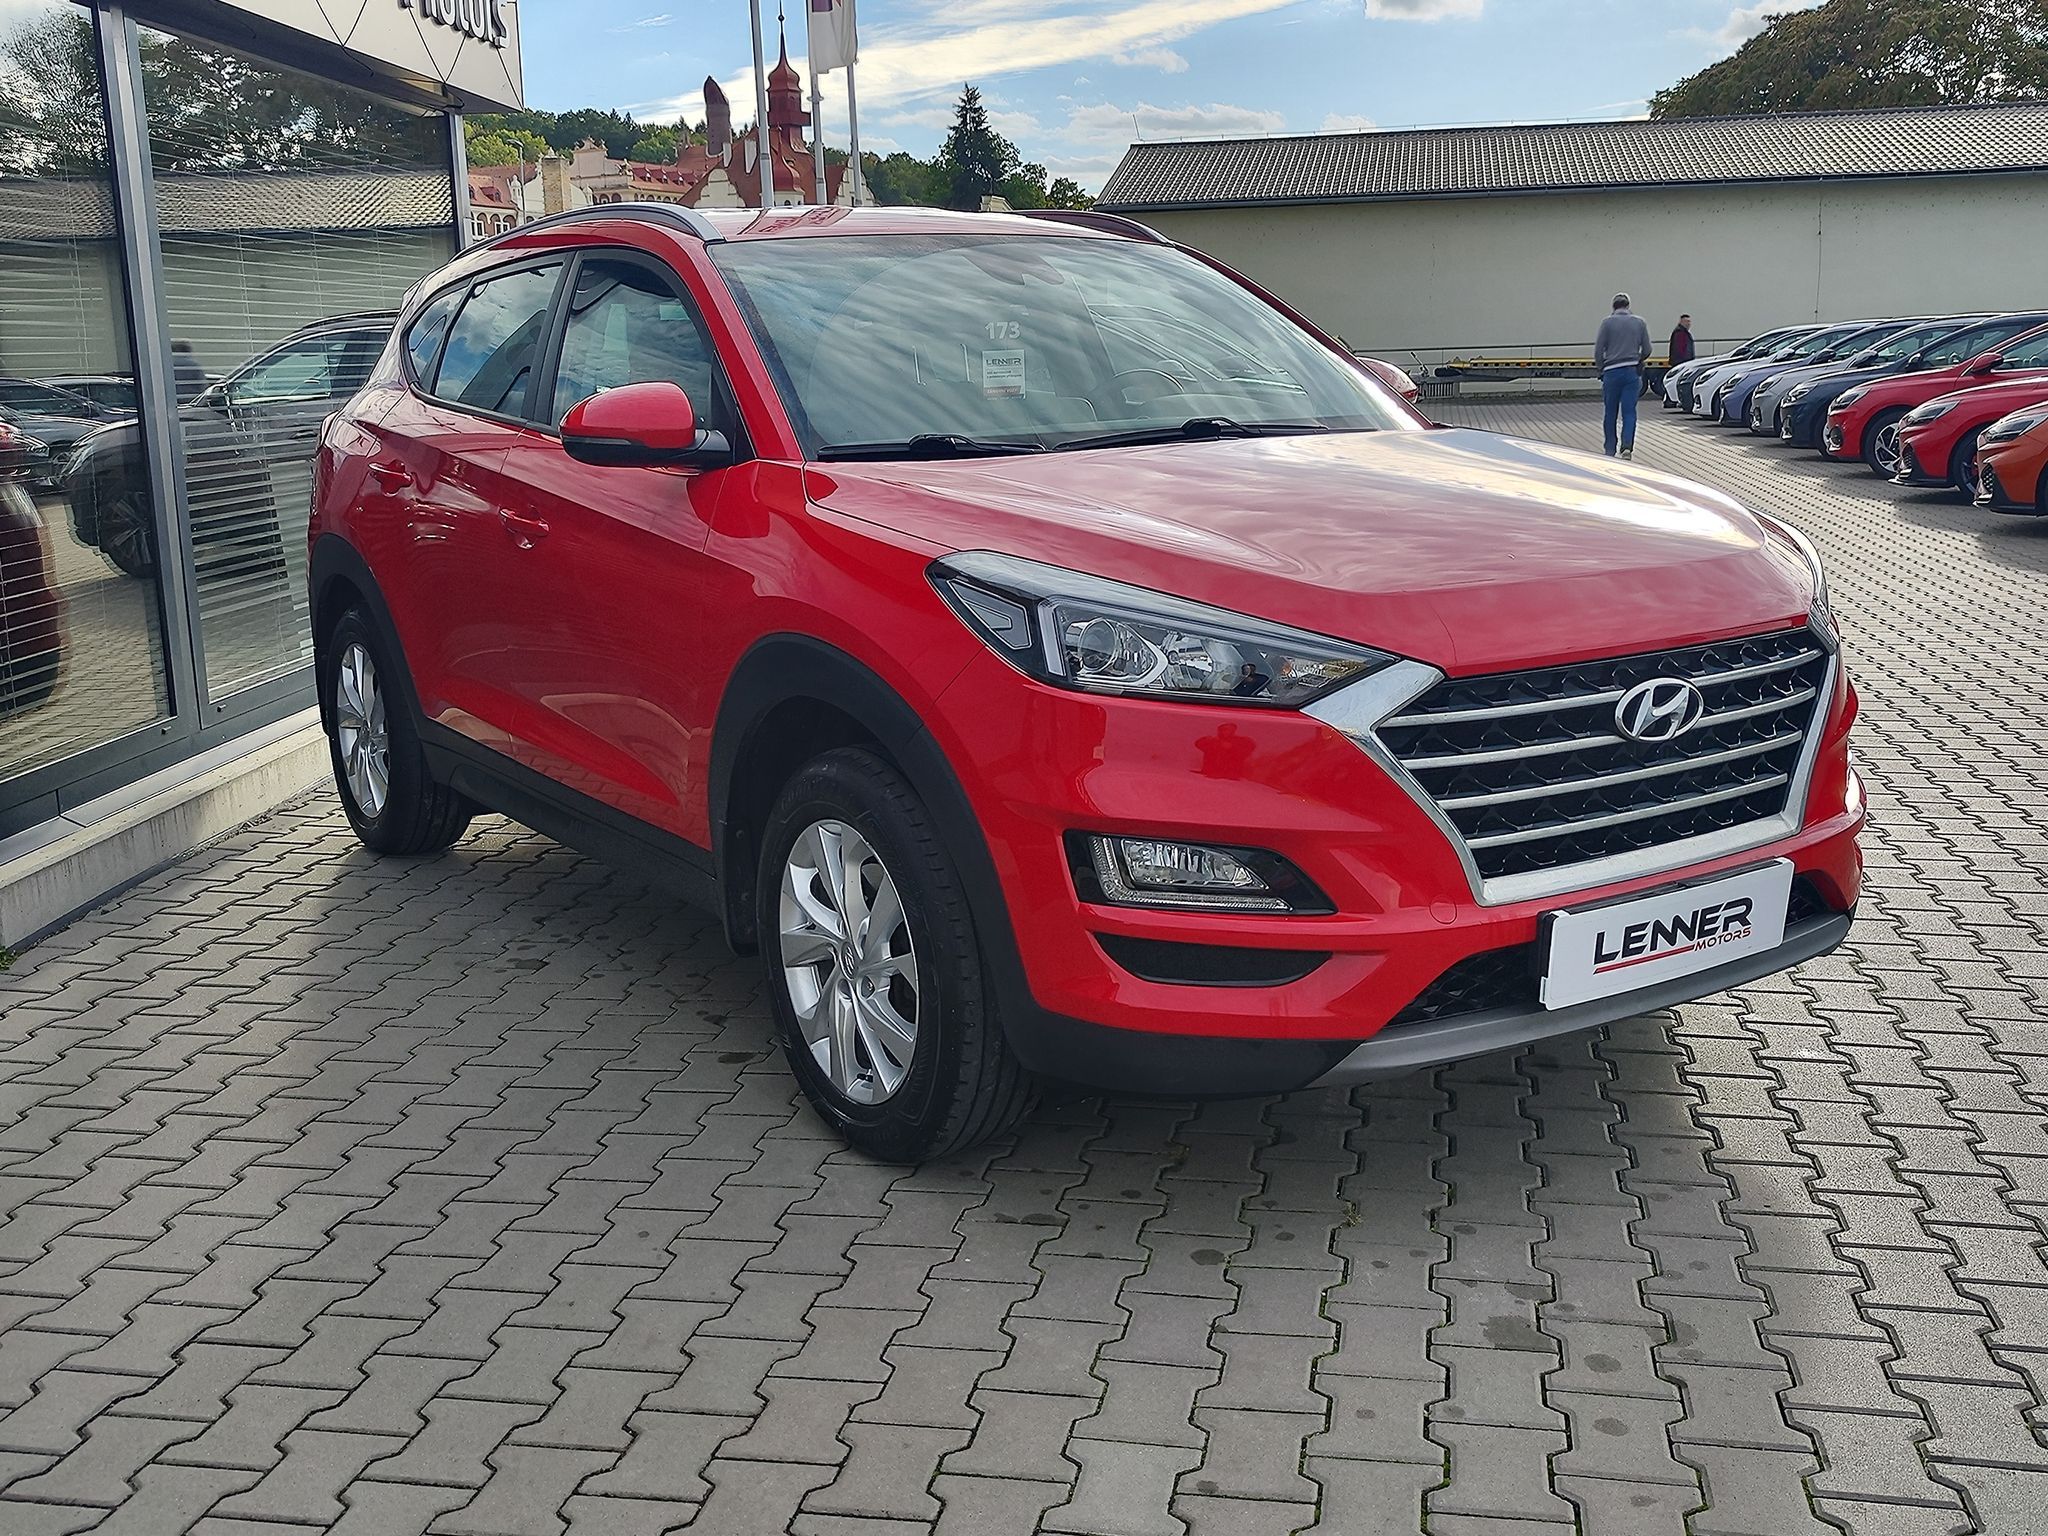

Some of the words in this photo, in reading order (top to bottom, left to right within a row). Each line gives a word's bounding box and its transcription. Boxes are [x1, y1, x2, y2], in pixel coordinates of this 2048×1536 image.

[985, 321, 1021, 339] 173
[1593, 897, 1753, 965] LENNER
[1694, 926, 1752, 952] MOTORS
